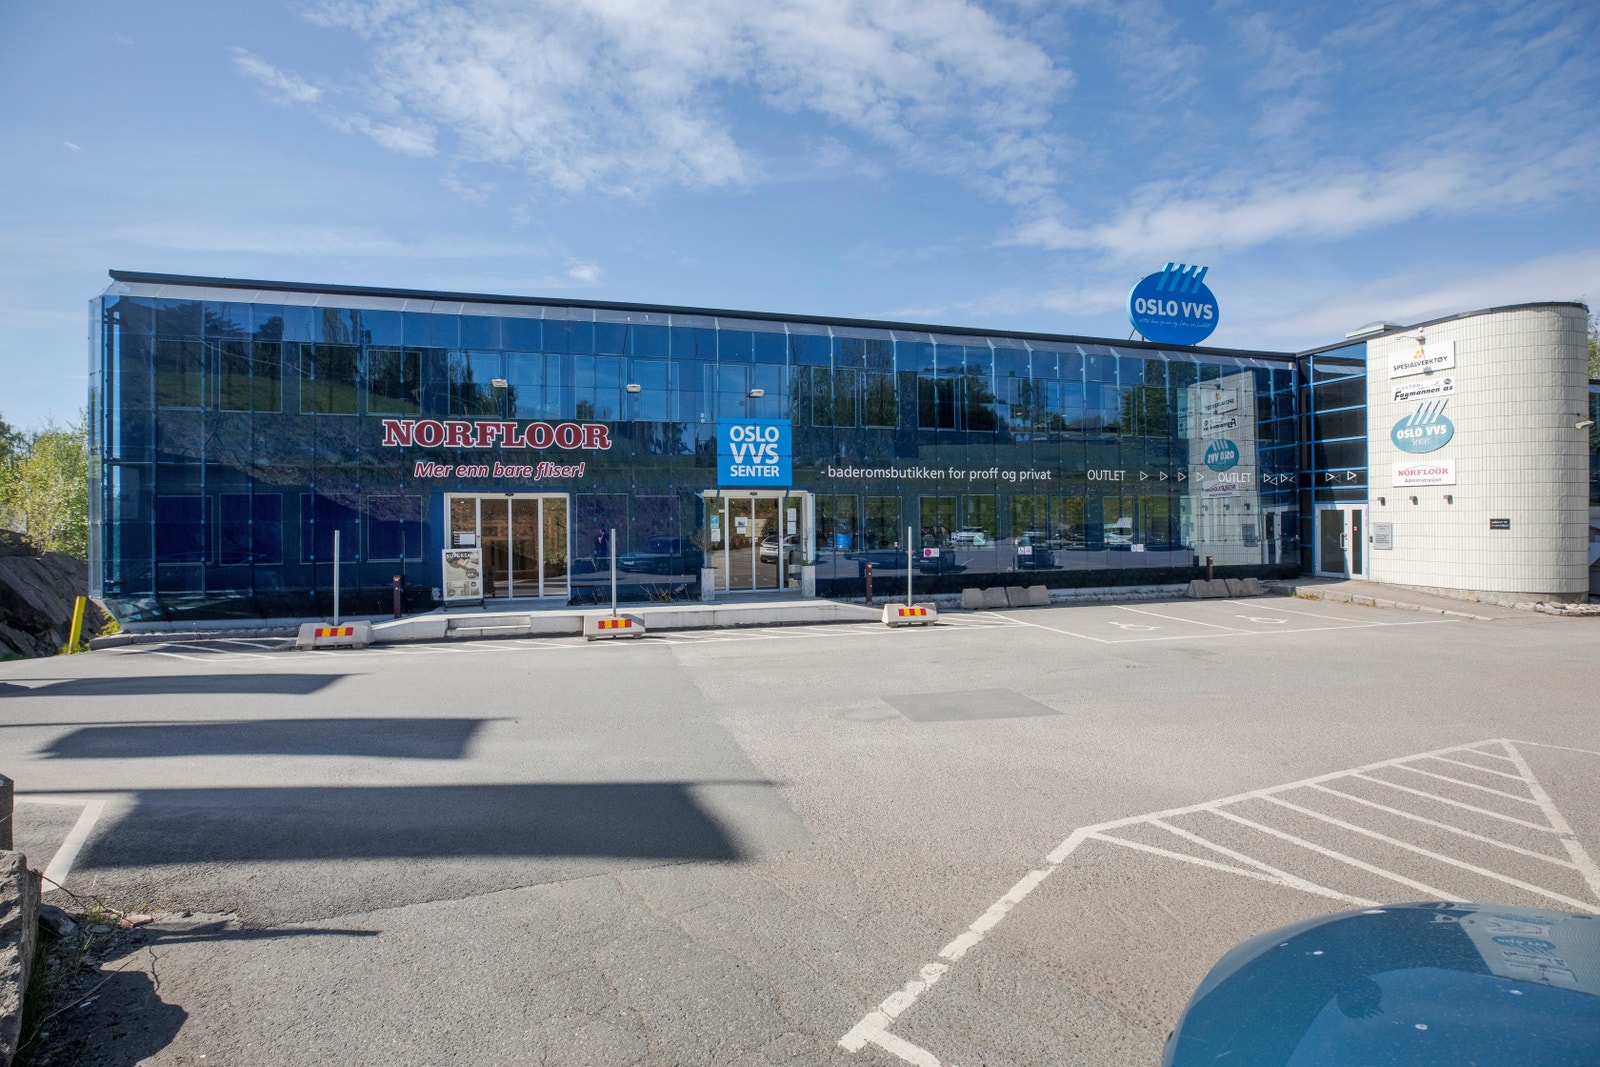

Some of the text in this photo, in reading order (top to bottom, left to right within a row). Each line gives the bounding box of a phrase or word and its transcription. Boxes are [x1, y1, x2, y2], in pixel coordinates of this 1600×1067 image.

[1135, 297, 1213, 320] OSLO VVS
[1393, 356, 1448, 371] SPESIALVERKTØY
[1394, 387, 1441, 401] Fagmannen
[382, 419, 612, 450] NORFLOOR
[729, 425, 780, 442] OSLO
[1397, 424, 1447, 439] OSLO VVS
[729, 443, 780, 464] VVS
[414, 462, 586, 480] Mer enn bare fliser!
[729, 465, 780, 477] SENTER
[948, 467, 966, 479] for
[969, 468, 999, 482] proff
[1001, 471, 1017, 482] og
[1019, 469, 1052, 482] privat
[1087, 469, 1126, 481] OUTLET
[1218, 472, 1252, 483] OUTLET
[1398, 468, 1449, 476] NORFLOOR
